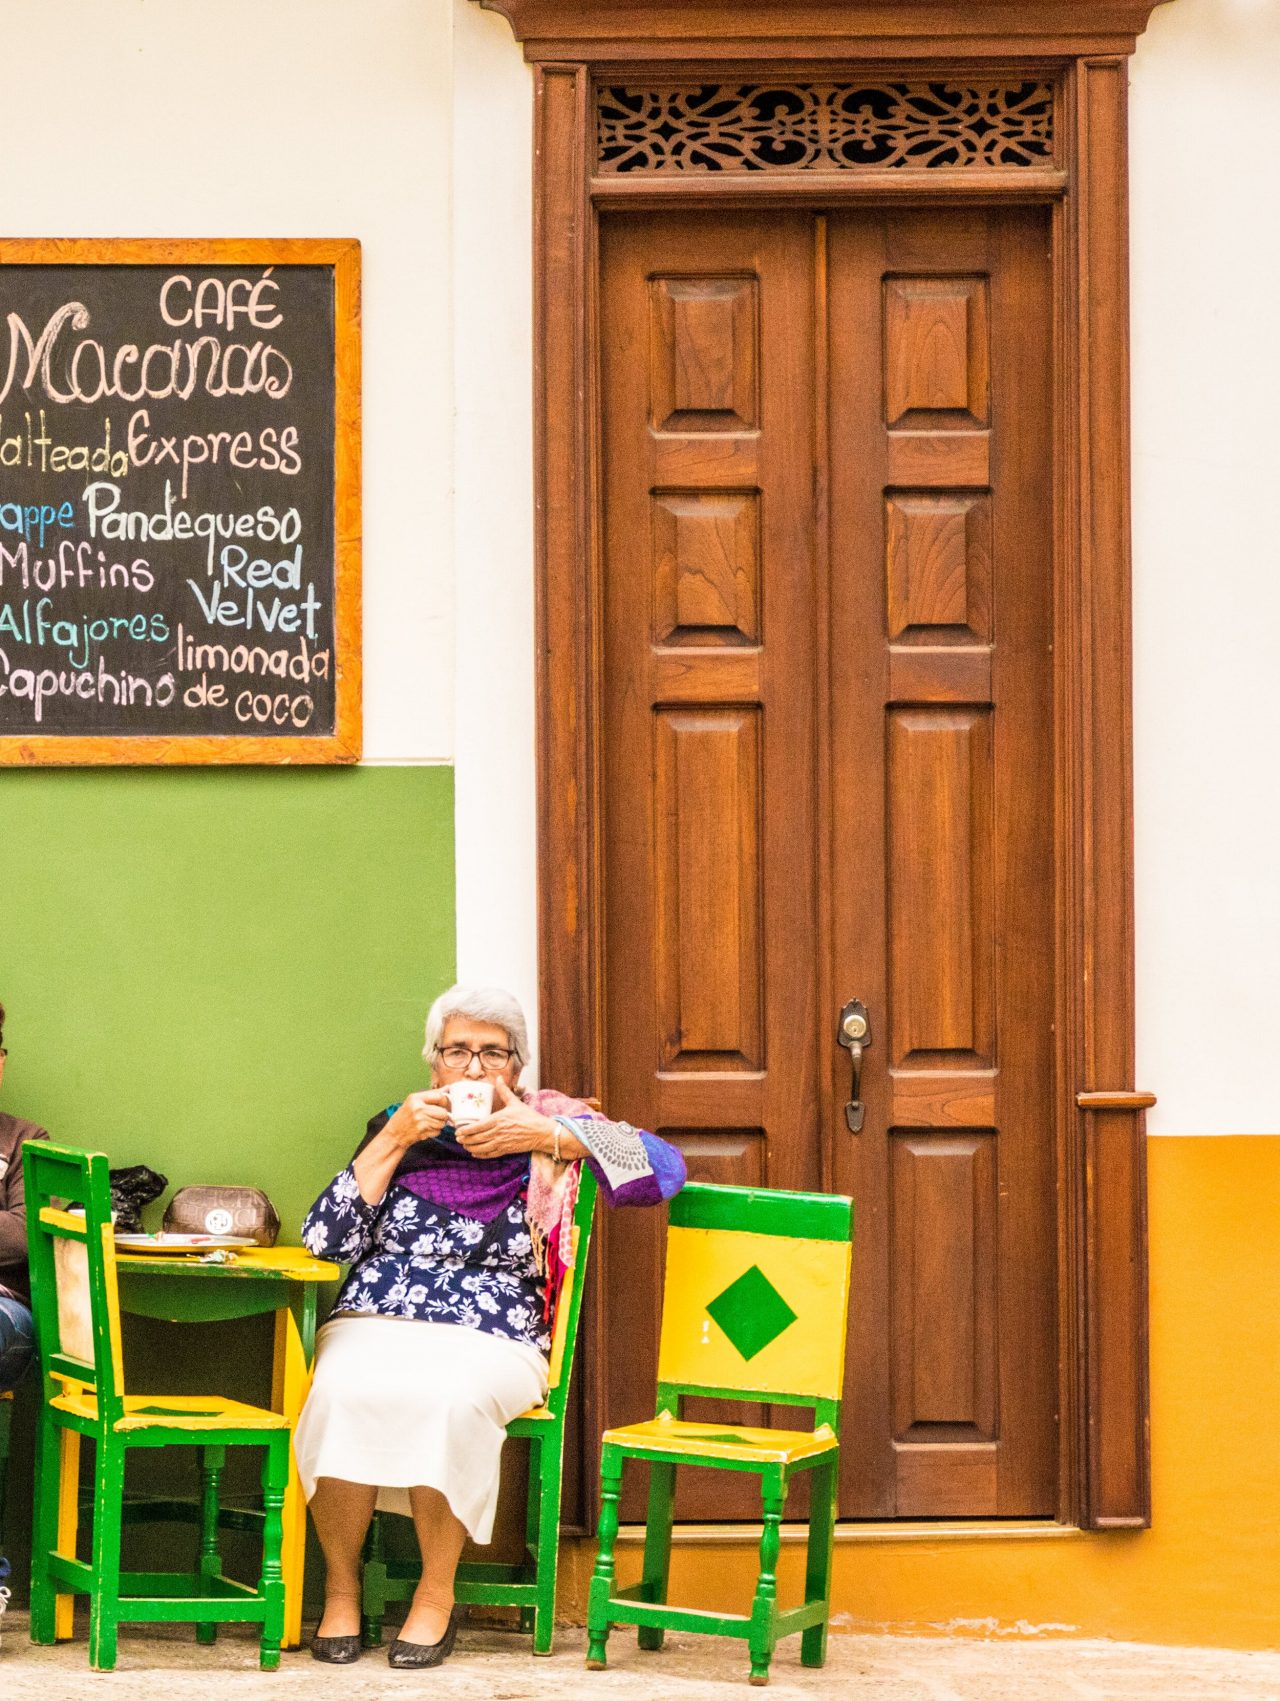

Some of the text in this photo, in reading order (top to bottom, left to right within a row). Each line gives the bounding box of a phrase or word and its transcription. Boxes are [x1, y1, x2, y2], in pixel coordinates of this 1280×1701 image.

[159, 267, 284, 332] CAFÉ
[127, 409, 303, 499] Express
[82, 479, 302, 576] Pandequeso
[220, 544, 303, 591] Red
[185, 579, 322, 640] Velvet
[177, 623, 330, 684] limonada
[183, 672, 315, 728] de coco
